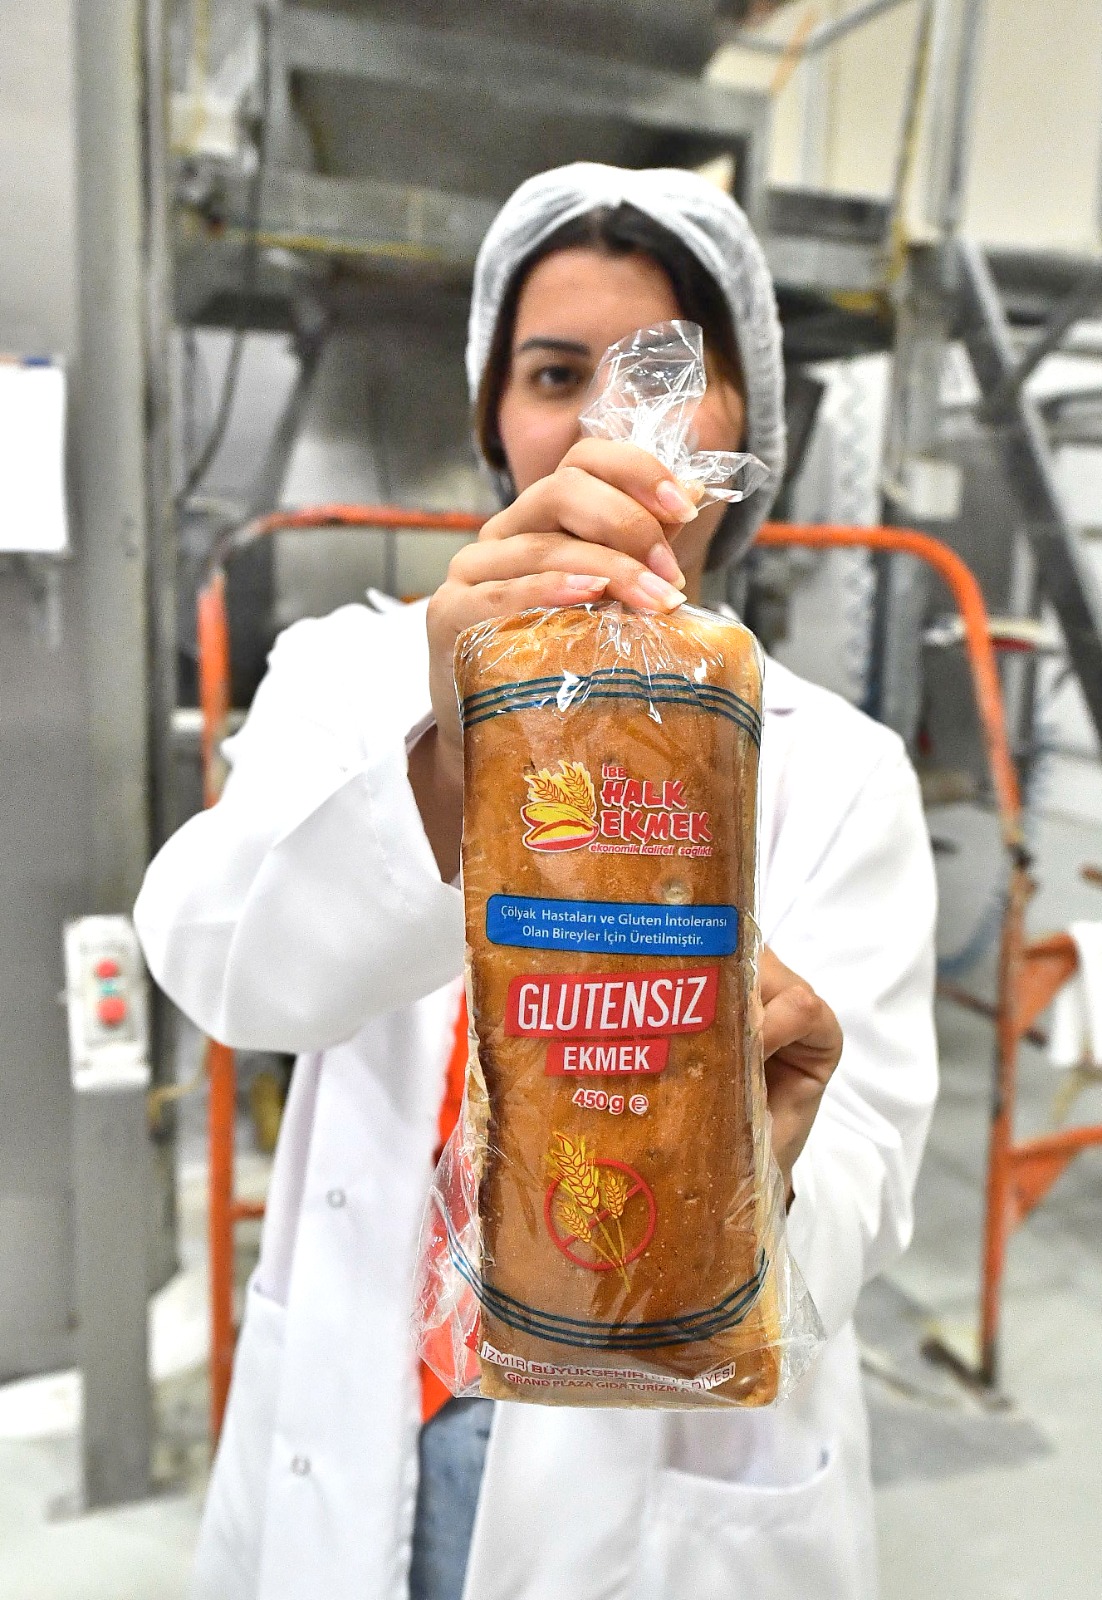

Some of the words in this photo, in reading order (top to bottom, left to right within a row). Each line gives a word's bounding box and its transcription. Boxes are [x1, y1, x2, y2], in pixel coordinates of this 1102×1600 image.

[601, 780, 687, 810] HALK
[600, 811, 713, 844] EKMEK
[590, 843, 639, 854] ekonomik
[501, 905, 536, 921] Çölyak
[542, 909, 596, 924] Hastaları
[600, 915, 615, 924] ve
[618, 913, 662, 927] Gluten
[665, 913, 727, 928] İntoleransı
[522, 925, 549, 938] Olan
[552, 928, 600, 943] Bireyler
[604, 928, 626, 944] İçin
[630, 930, 704, 947] Üretilmiştir.
[563, 1045, 651, 1071] EKMEK
[572, 1088, 608, 1111] 450
[608, 1095, 624, 1115] g
[507, 1374, 550, 1387] GRAND
[553, 1380, 593, 1388] PLAZA
[629, 1383, 677, 1392] TURİZM
